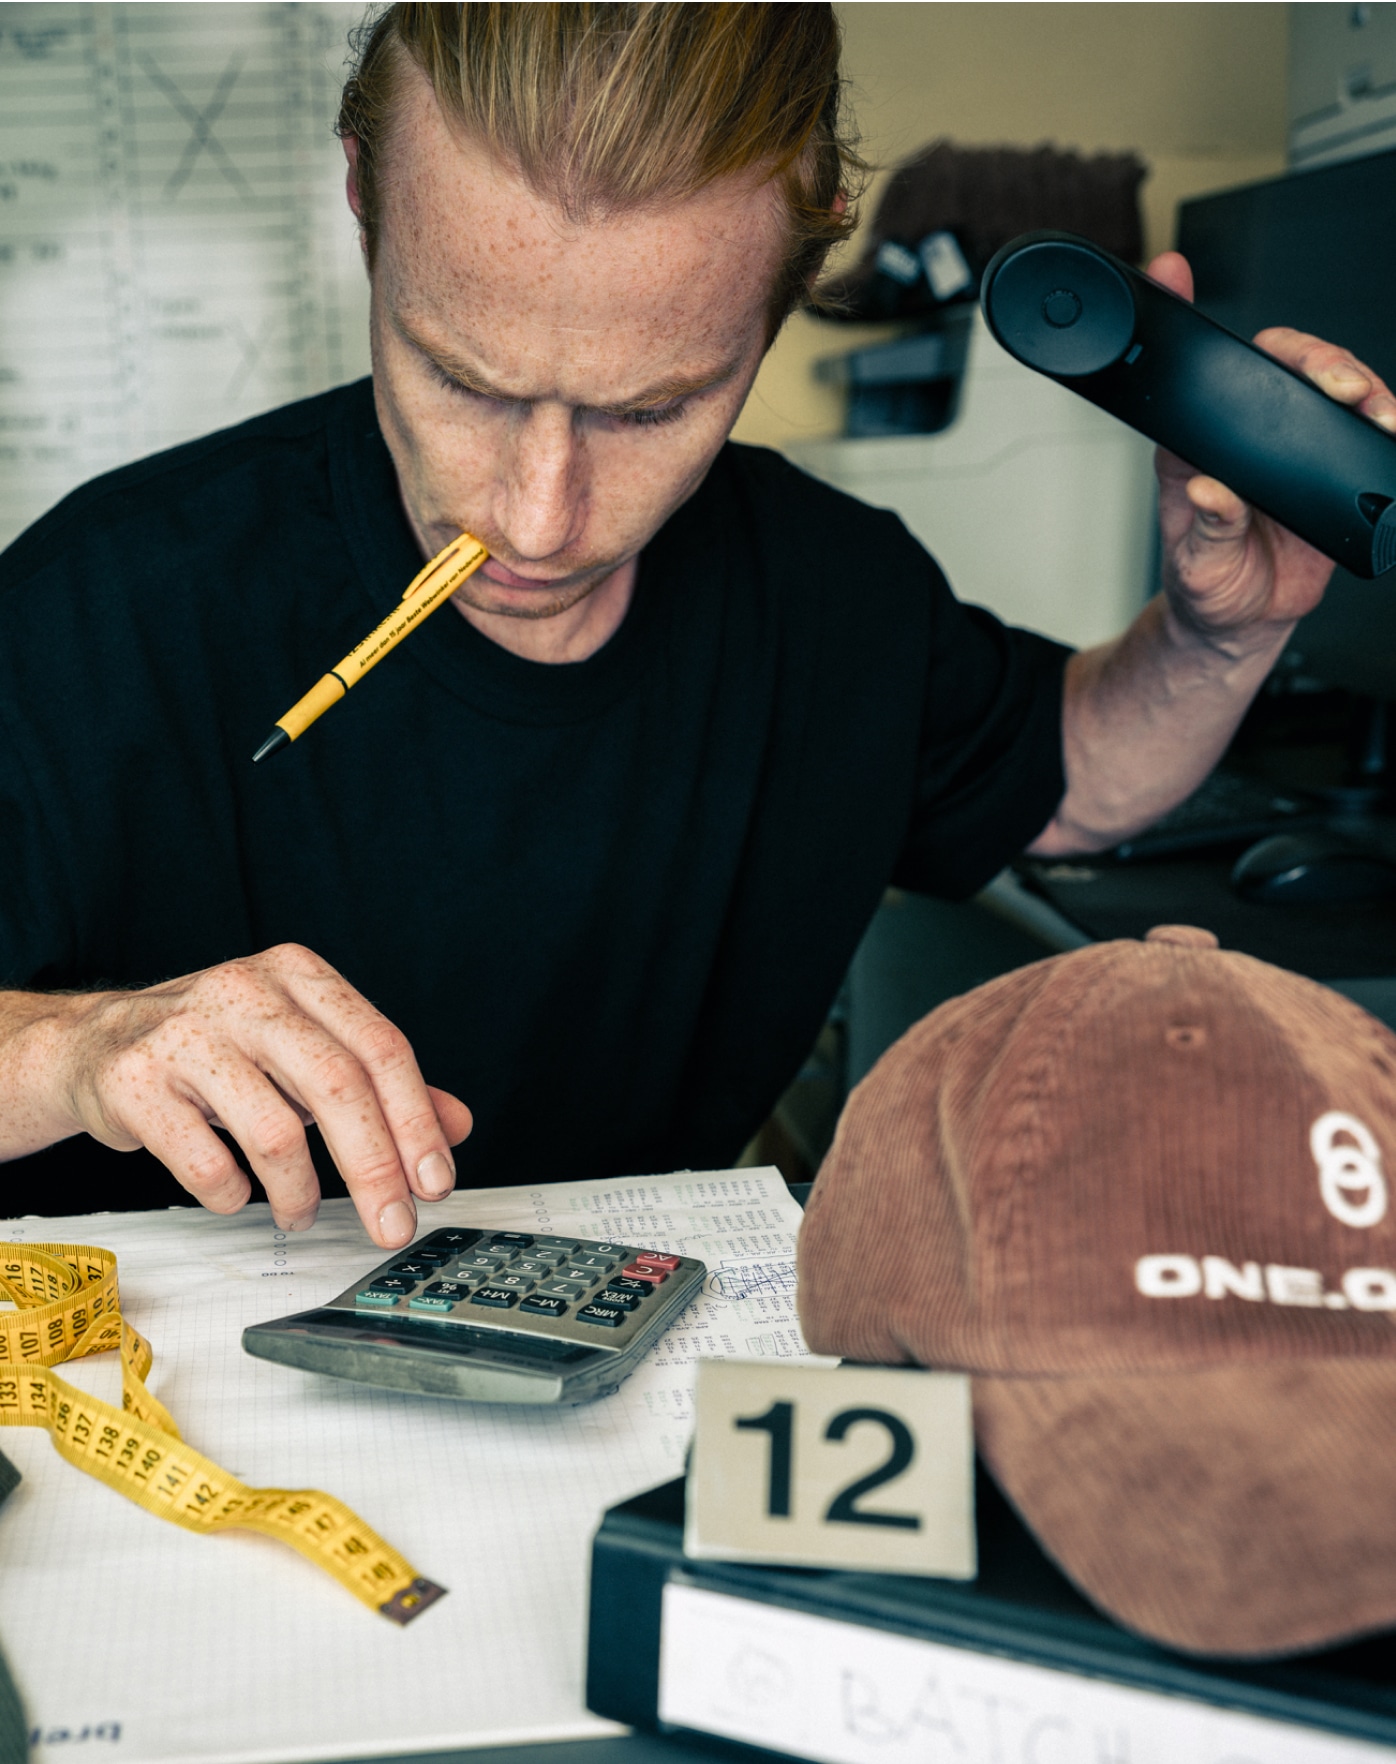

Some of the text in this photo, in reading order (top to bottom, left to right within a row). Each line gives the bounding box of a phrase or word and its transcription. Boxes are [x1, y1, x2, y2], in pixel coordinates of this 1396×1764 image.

[365, 646, 379, 662] meer
[379, 637, 390, 649] dan
[396, 622, 407, 635] jaar
[406, 607, 422, 623] Beste
[421, 581, 449, 609] Webwinkel
[449, 572, 459, 583] van
[458, 548, 484, 574] Nederland
[489, 1245, 505, 1253] 3
[536, 1250, 552, 1258] 2
[598, 1245, 612, 1253] 0
[473, 1257, 489, 1265] 6
[586, 1257, 596, 1265] 1
[643, 1252, 673, 1262] AC
[87, 1264, 102, 1281] 37
[520, 1262, 536, 1270] 5
[569, 1269, 585, 1278] 4
[635, 1265, 653, 1274] C
[30, 1266, 44, 1292] 117
[457, 1270, 473, 1278] 9
[504, 1276, 520, 1285] 8
[47, 1274, 59, 1300] 118
[480, 1289, 511, 1300] M+
[552, 1284, 568, 1292] 7
[363, 1291, 392, 1299] TAX+
[416, 1297, 445, 1305] TAX-
[601, 1290, 634, 1300] M/EX
[93, 1297, 103, 1318] 10
[529, 1298, 560, 1308] M-
[584, 1305, 619, 1318] MRC
[71, 1308, 88, 1338] 109
[48, 1318, 64, 1348] 108
[20, 1332, 39, 1358] 107
[0, 1381, 18, 1408] 133
[29, 1382, 47, 1410] 134
[56, 1402, 70, 1433] 136
[72, 1412, 92, 1446] 137
[95, 1425, 119, 1458] 138
[116, 1438, 140, 1469] 139
[134, 1449, 161, 1480] 140
[733, 1399, 922, 1532] 12
[158, 1465, 188, 1496] 141
[186, 1483, 218, 1514] 142
